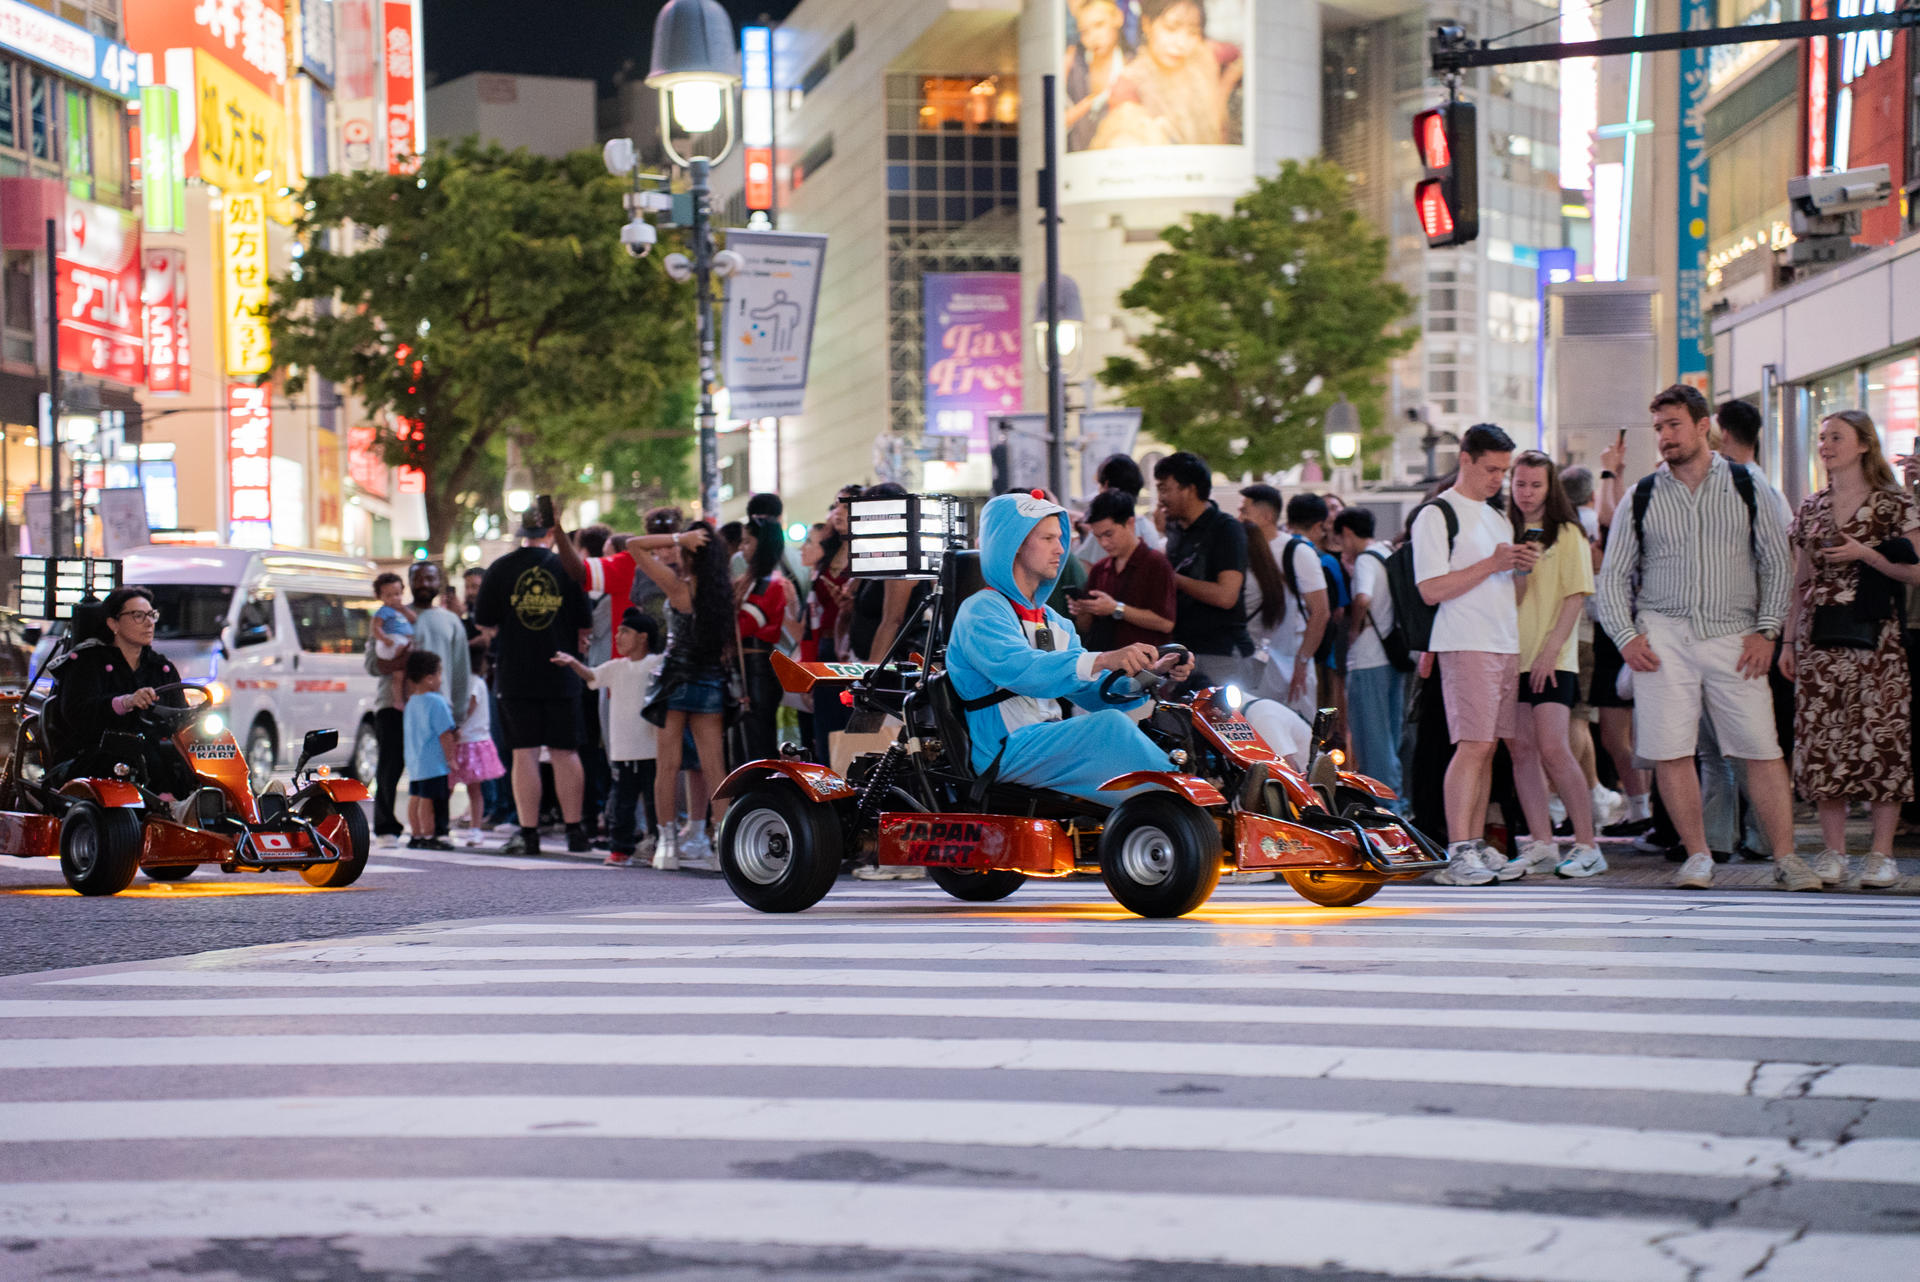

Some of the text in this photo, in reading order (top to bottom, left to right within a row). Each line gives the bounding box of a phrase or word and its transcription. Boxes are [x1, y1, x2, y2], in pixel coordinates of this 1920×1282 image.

[102, 44, 136, 94] 4F
[229, 199, 258, 318] 処方せん
[71, 269, 128, 328] アコム
[929, 358, 1022, 395] Free
[1212, 723, 1251, 731] JAPAN
[1224, 732, 1255, 741] KART
[189, 744, 236, 752] JAPAN
[196, 751, 235, 759] KART
[902, 823, 983, 841] JAPAN
[907, 844, 975, 864] KART
